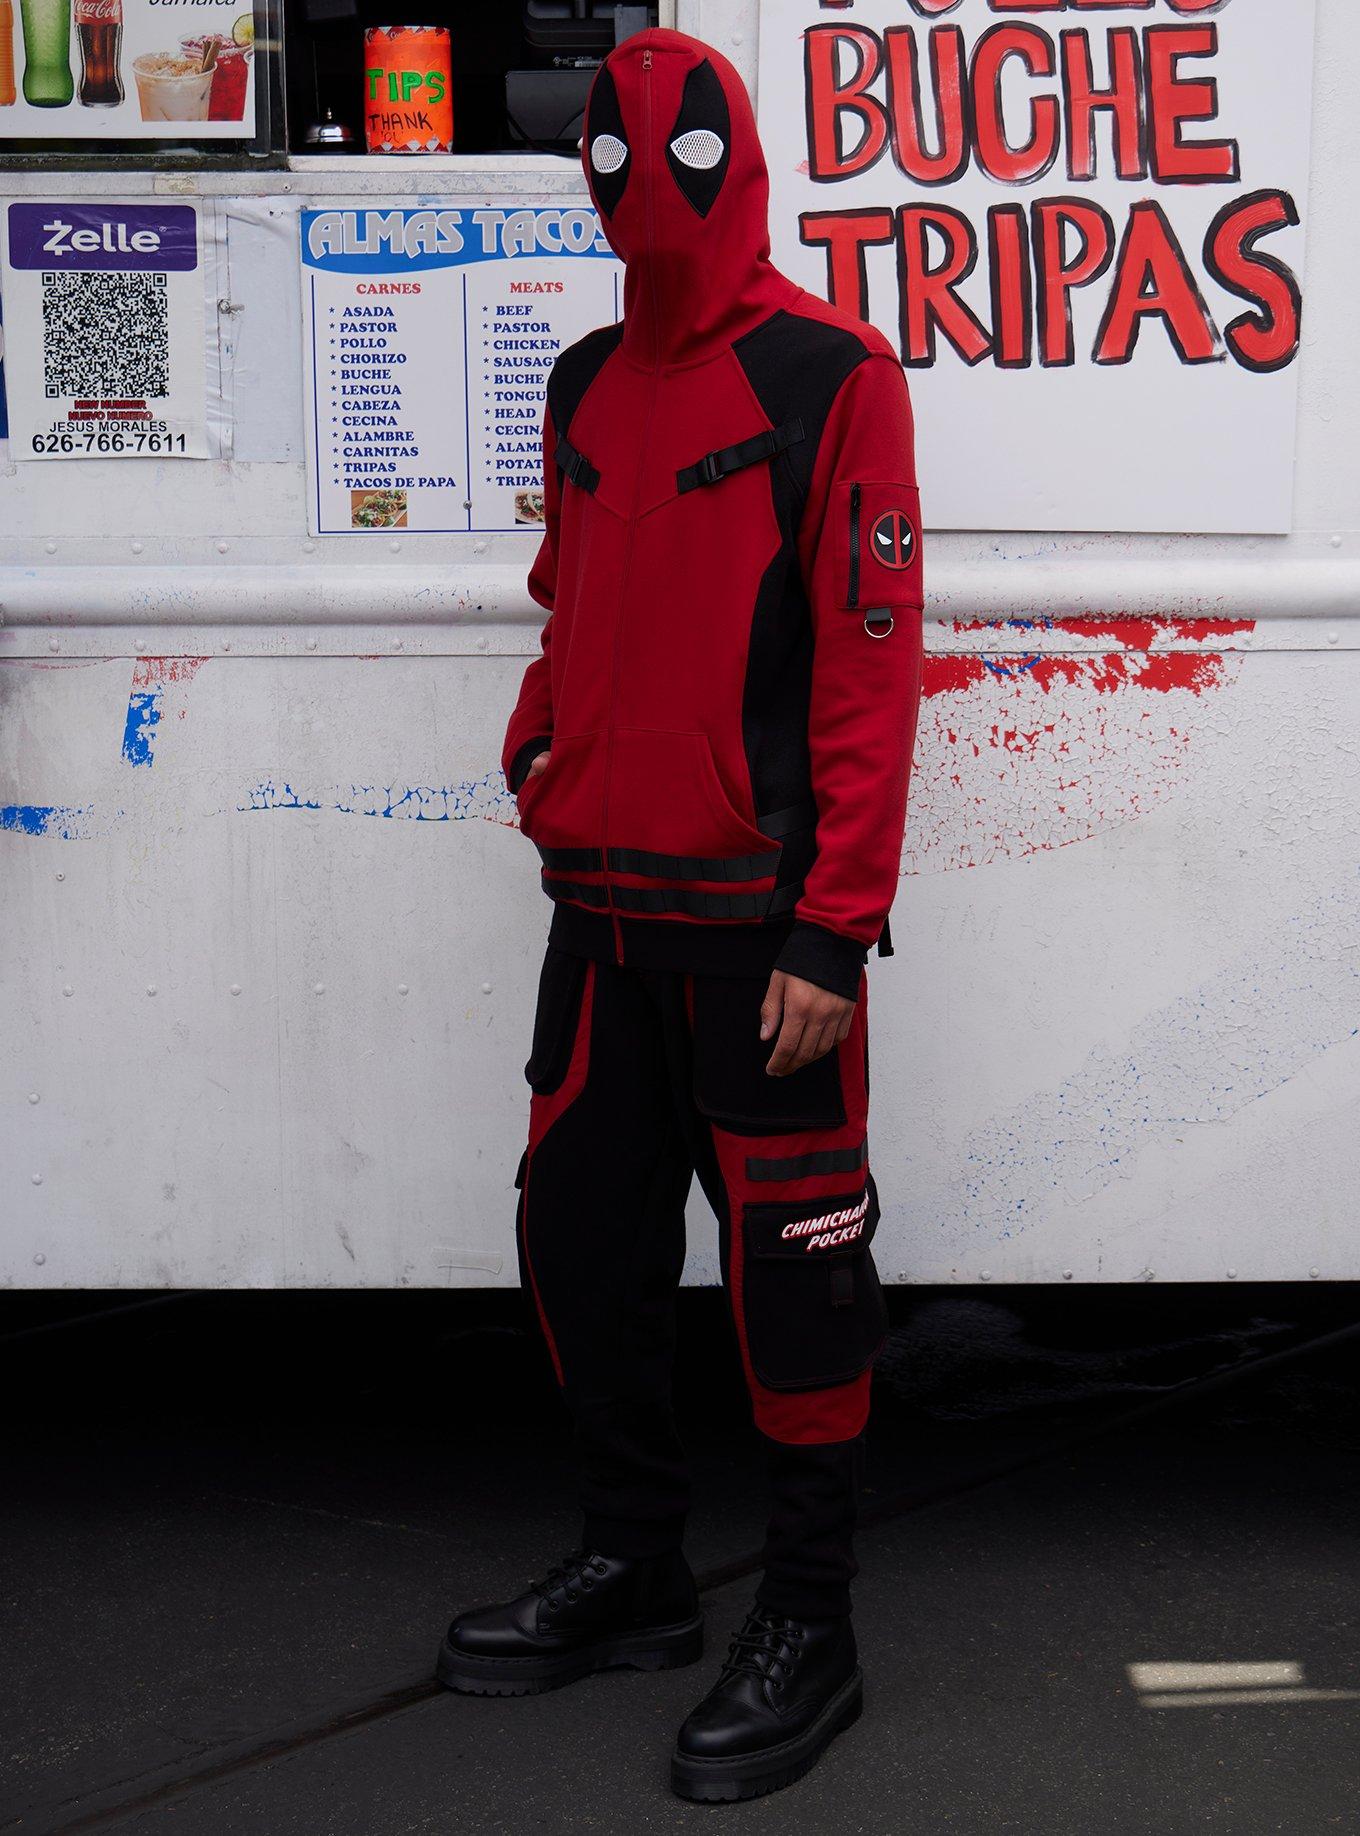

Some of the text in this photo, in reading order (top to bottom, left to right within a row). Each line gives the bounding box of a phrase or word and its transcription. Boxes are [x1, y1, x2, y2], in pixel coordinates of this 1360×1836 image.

[365, 68, 446, 104] TIPS
[803, 21, 1241, 187] BUCHE
[368, 111, 433, 131] THANK
[43, 220, 161, 256] Zelle
[308, 209, 465, 259] ALMAS
[799, 188, 1302, 374] TRIPAS
[356, 283, 421, 294] CARNES
[510, 282, 564, 293] MEATS
[342, 306, 395, 317] ASADA
[496, 305, 533, 316] BEEF
[340, 322, 398, 333] PASTOR
[493, 322, 551, 333] PASTOR
[340, 338, 387, 348] POLLO
[493, 339, 561, 350] CHICKEN
[340, 353, 407, 364] CHORIZO
[341, 369, 391, 380] BUCHE
[494, 373, 544, 384] BUCHE
[341, 385, 402, 395] LENGUA
[494, 391, 547, 401] TONGU
[74, 400, 147, 410] NEW NUMBER
[341, 400, 401, 411] CABEZA
[68, 411, 153, 421] NUEVO NUMERO
[494, 408, 536, 419] HEAD
[342, 415, 398, 426] CECINA
[50, 421, 167, 433] JESUS MORALES
[495, 425, 543, 436] CECIN
[342, 431, 415, 442] ALAMBRE
[32, 433, 186, 453] 626-766-7611
[343, 446, 419, 457] CARNITAS
[343, 462, 397, 473] TRIPAS
[496, 459, 544, 470] POTAT
[343, 476, 456, 488] TACOS DE PAPA
